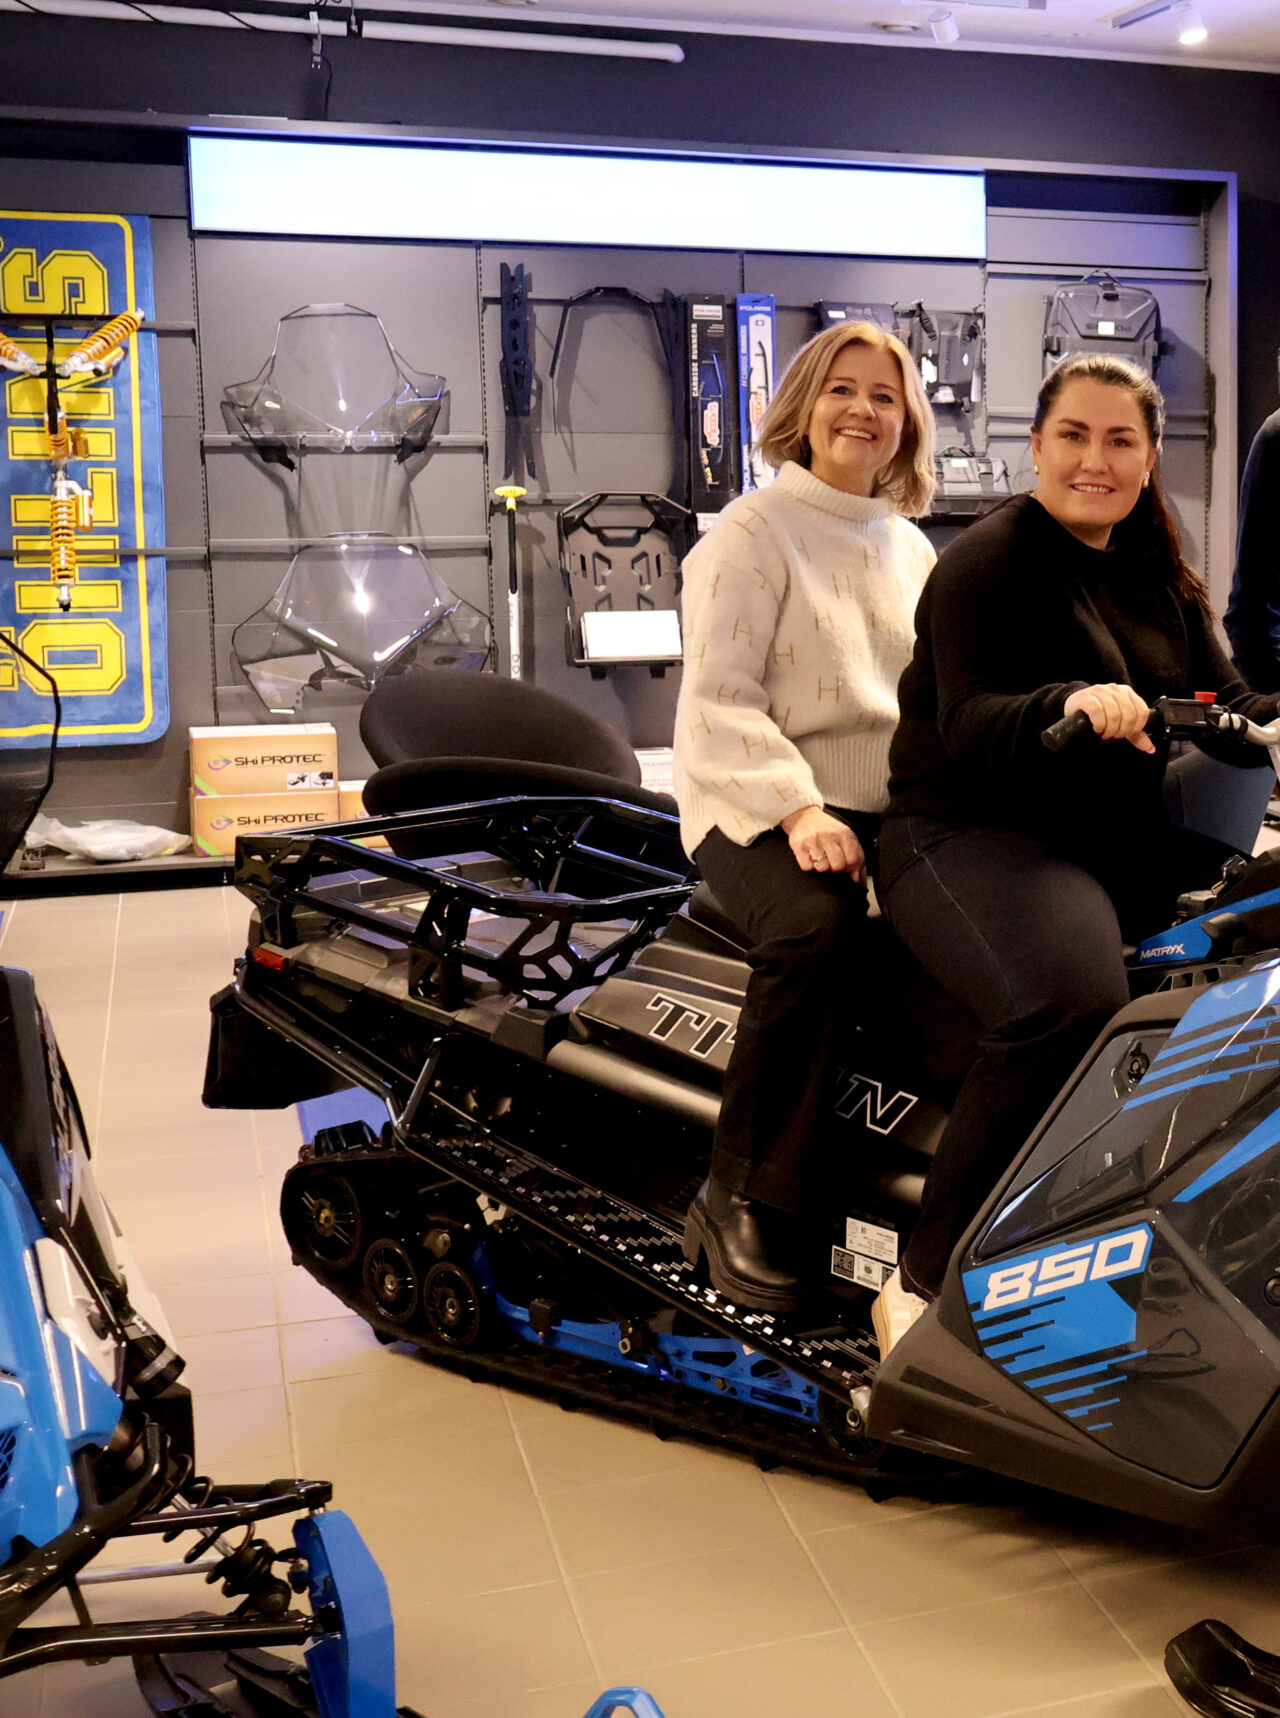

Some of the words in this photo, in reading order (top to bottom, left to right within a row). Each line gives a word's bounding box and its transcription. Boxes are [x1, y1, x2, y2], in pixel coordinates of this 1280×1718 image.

[261, 753, 323, 764] PROTEC
[263, 812, 325, 825] PROTEC
[1139, 943, 1186, 961] MATRYX
[983, 1228, 1149, 1312] 850
